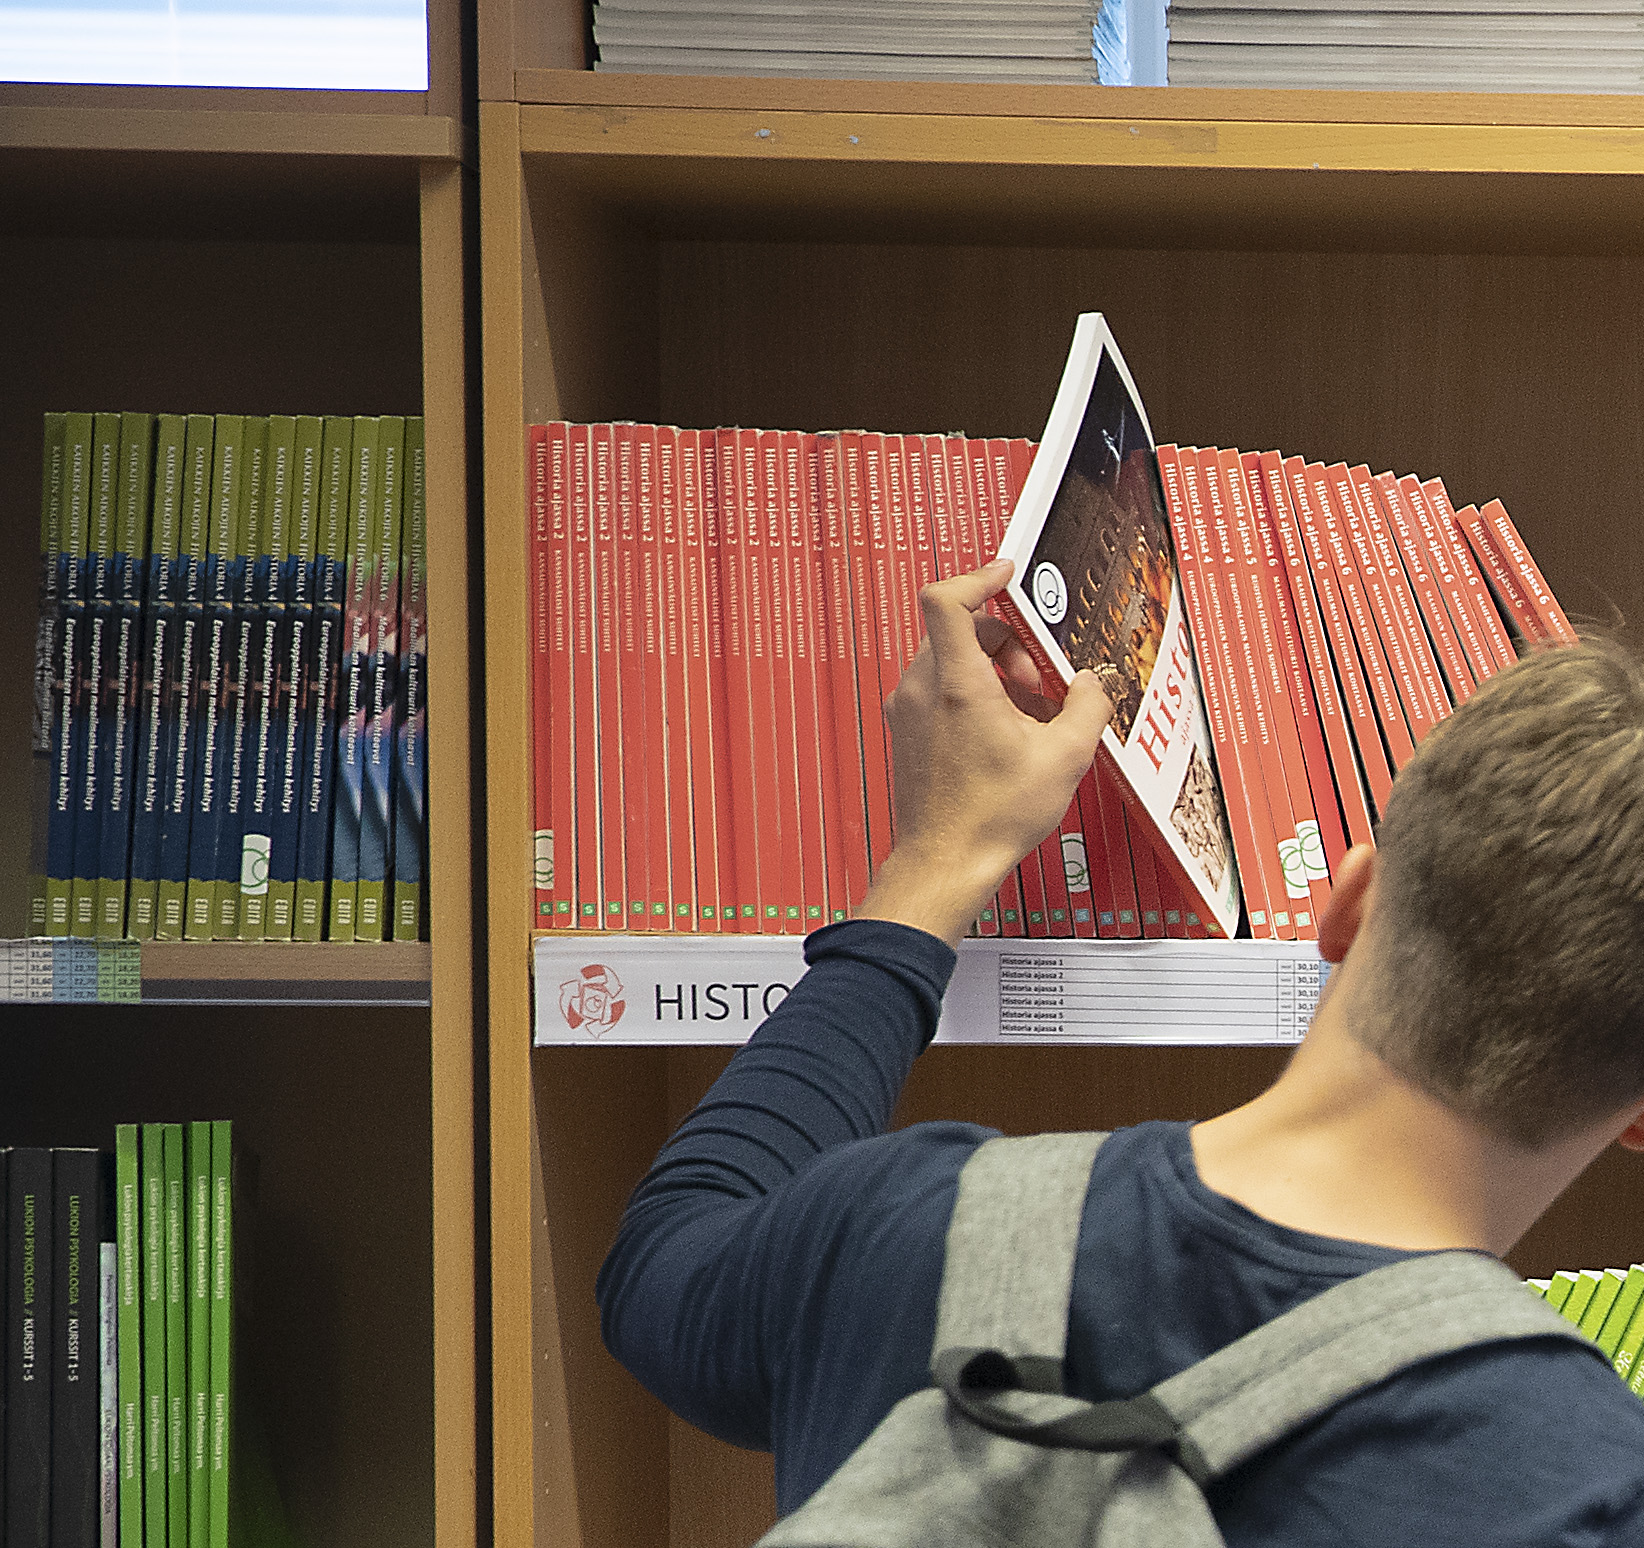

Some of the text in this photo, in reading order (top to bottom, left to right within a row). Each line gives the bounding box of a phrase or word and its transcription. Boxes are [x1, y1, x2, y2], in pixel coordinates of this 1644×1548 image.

[553, 440, 565, 491] Historia
[551, 493, 564, 529] ajassa
[1206, 466, 1222, 518] Historia
[1214, 519, 1230, 555] ajassa
[1225, 556, 1234, 564] 4
[1268, 470, 1286, 520] Historia
[1278, 521, 1296, 556] ajassa
[1290, 558, 1300, 566] 6
[1135, 620, 1191, 775] Histo
[1002, 957, 1031, 966] Historia
[1033, 959, 1057, 967] ajassa
[1298, 963, 1318, 971] 30,10
[1002, 971, 1031, 979] Historia
[1033, 972, 1057, 981] ajassa
[1298, 977, 1318, 985] 30,10
[655, 983, 792, 1021] HISTO
[1002, 1024, 1031, 1032] Historia
[1033, 1025, 1057, 1034] ajassa
[24, 1195, 35, 1234] LUKION
[24, 1236, 35, 1305] PSYKOLOGIA
[23, 1318, 35, 1360] KURSSIT
